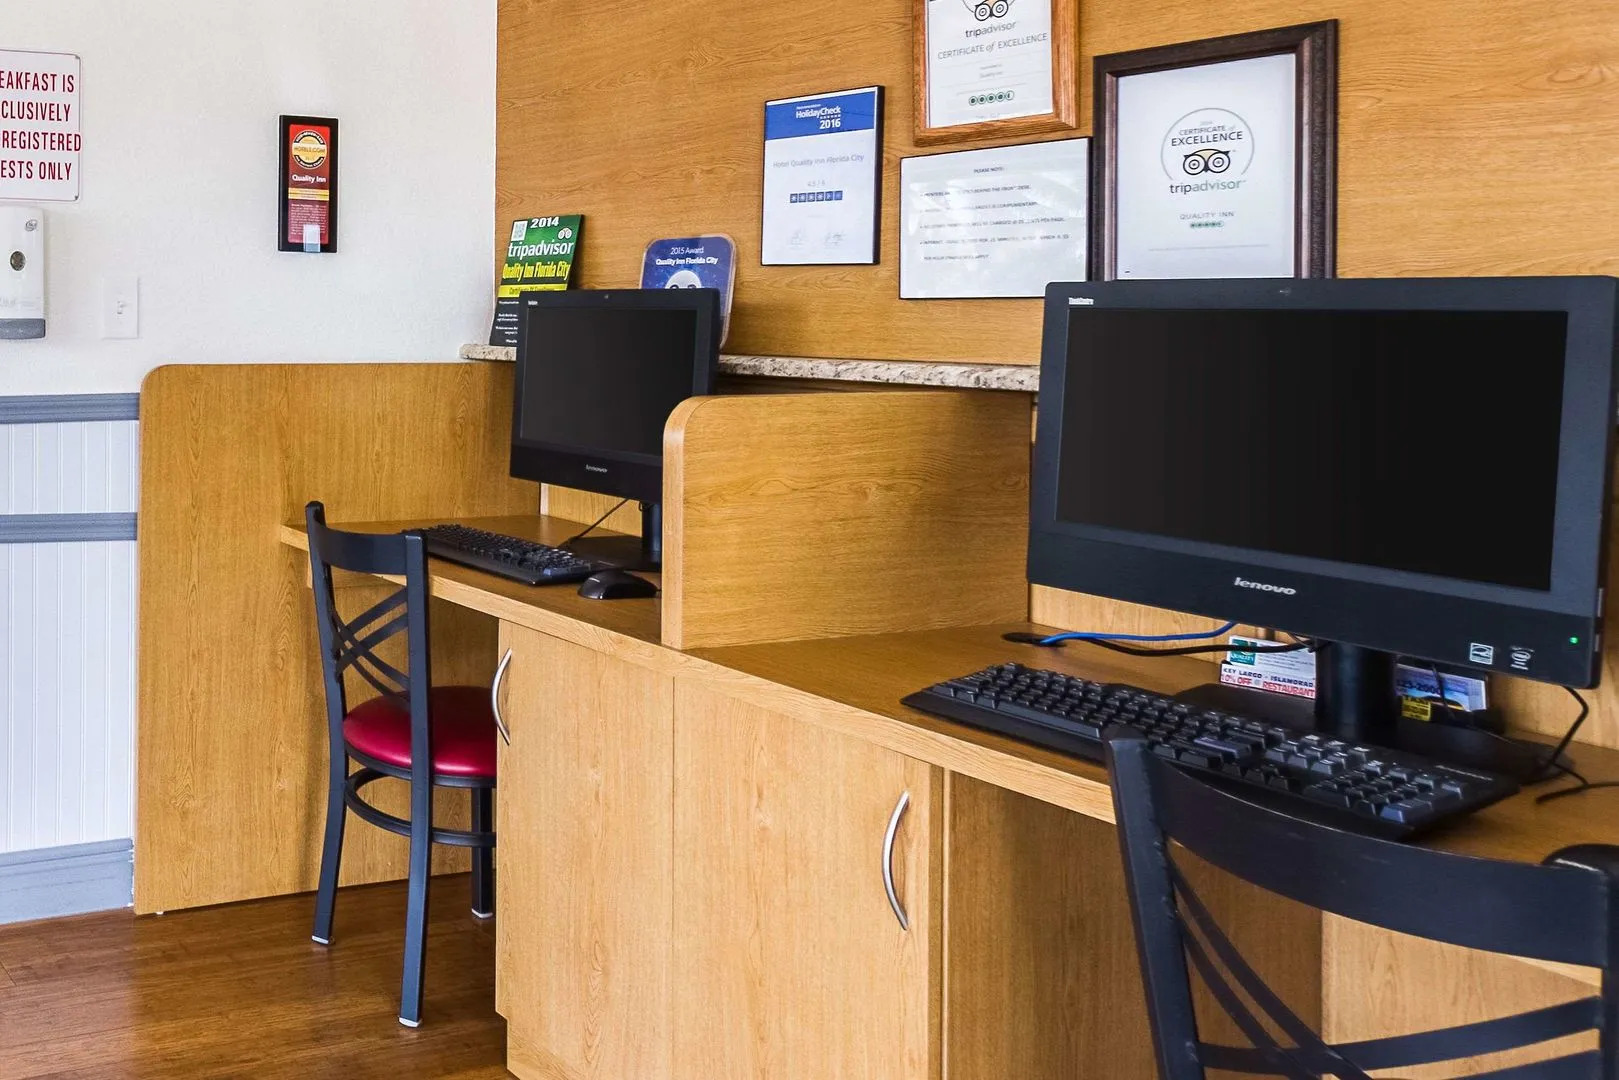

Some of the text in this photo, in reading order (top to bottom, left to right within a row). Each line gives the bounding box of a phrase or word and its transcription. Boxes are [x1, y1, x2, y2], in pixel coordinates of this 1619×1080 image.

[965, 22, 1016, 38] tripadvisor
[938, 32, 1048, 60] CERTIFICATE of EXCELLENCE
[62, 74, 74, 92] IS
[1, 100, 71, 122] CLUSIVELY
[796, 106, 841, 118] HolidayCheck
[820, 118, 841, 129] 2016
[1179, 126, 1226, 136] CERTIFICATE
[2, 130, 81, 152] REGISTERED
[1171, 131, 1243, 147] EXCELLENCE
[790, 160, 813, 168] Quality
[850, 154, 865, 162] City
[0, 160, 72, 180] ESTS ONLY
[291, 174, 316, 184] Quality
[1170, 179, 1242, 195] tripadvisor
[530, 216, 560, 228] 2014
[1180, 210, 1236, 220] QUALITY INN
[508, 239, 574, 260] tripadvisor
[670, 246, 704, 255] 2015 Award
[656, 258, 676, 266] Quality
[686, 257, 706, 265] Florida
[706, 256, 718, 264] City
[502, 261, 572, 282] Quality Inn Florida City
[1234, 576, 1296, 595] lenovo
[1238, 670, 1262, 678] LARGO
[1238, 676, 1252, 686] OFF
[1262, 680, 1316, 697] RESTAURANT
